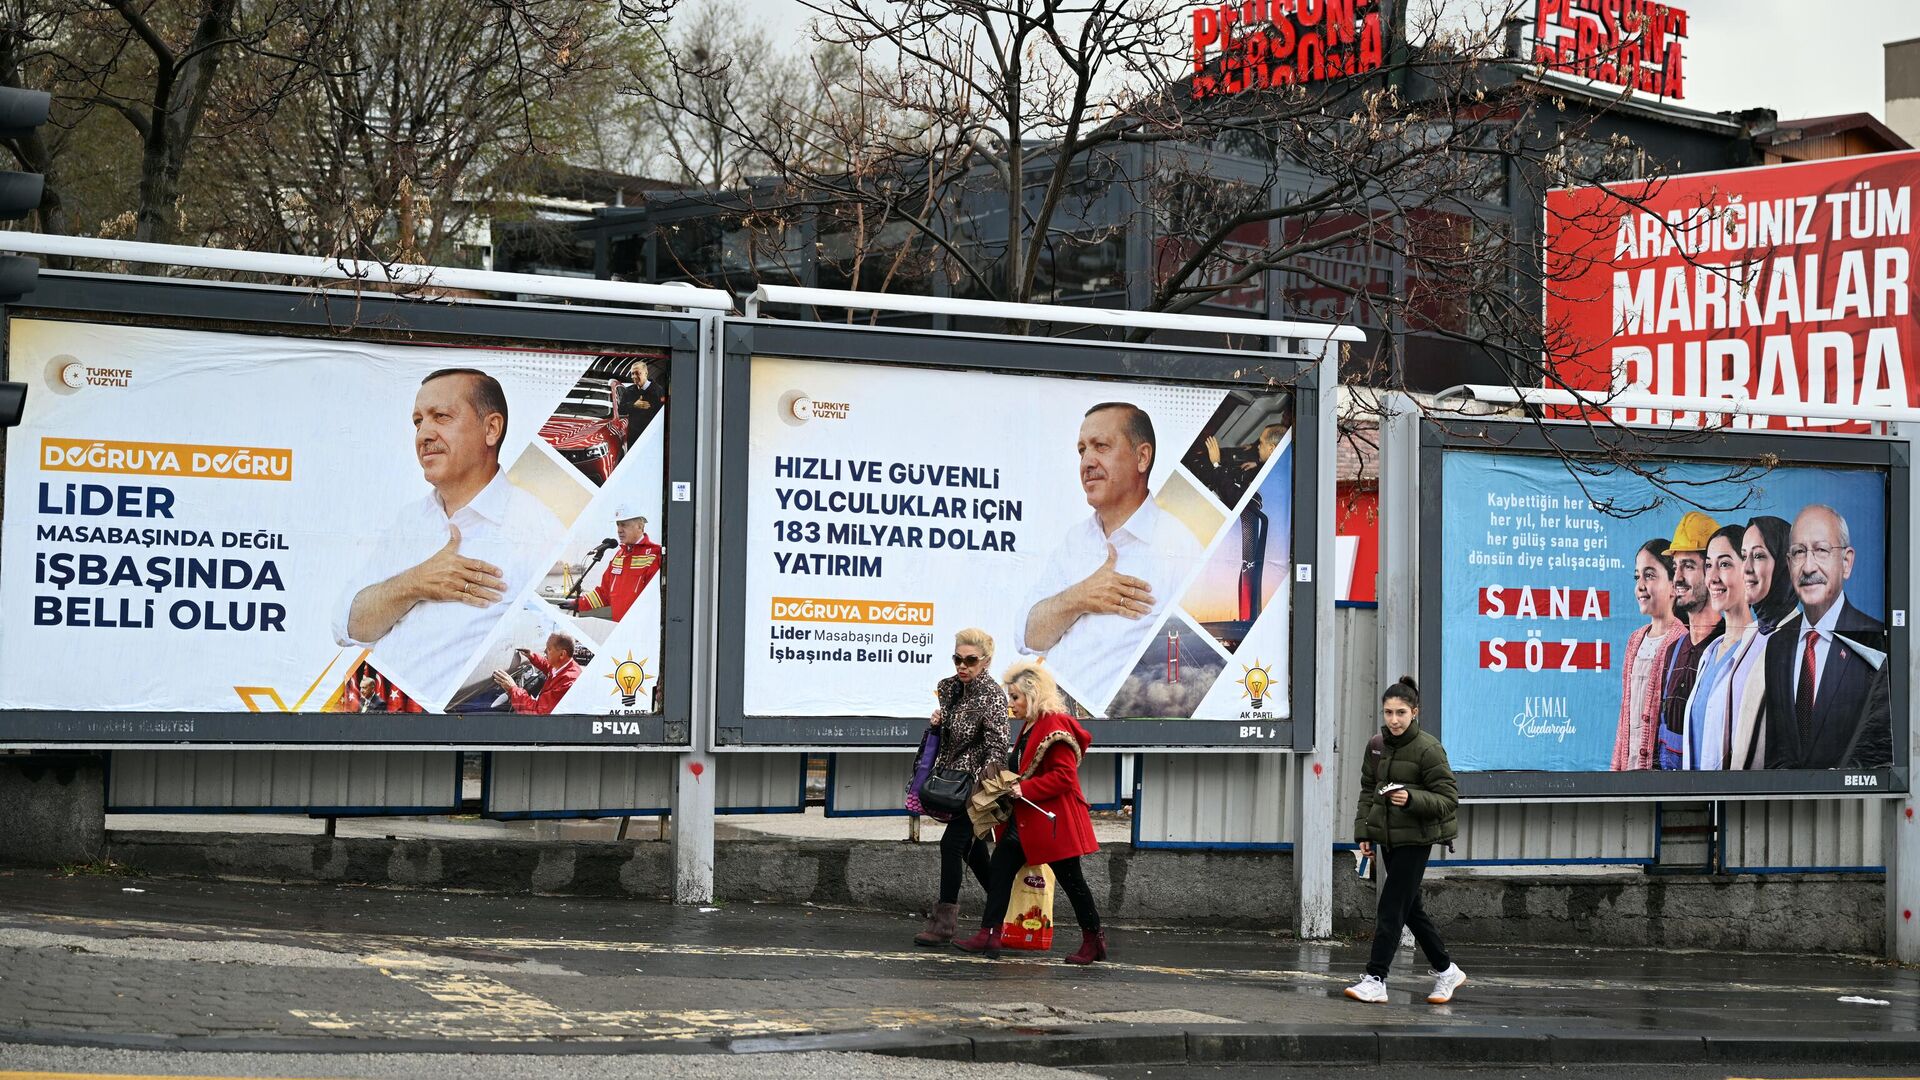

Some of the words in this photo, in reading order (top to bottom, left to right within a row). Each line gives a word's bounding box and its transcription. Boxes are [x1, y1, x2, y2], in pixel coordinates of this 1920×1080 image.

[1614, 195, 1817, 260] ARADIĞINIZ
[1826, 182, 1911, 241] TÜM
[1612, 247, 1910, 337] MARKALAR
[1611, 327, 1910, 429] BURADA
[45, 443, 181, 472] DOĞRUYA
[192, 451, 288, 476] DOĞRU
[775, 456, 842, 481] HIZLI
[848, 460, 882, 483] VE
[888, 463, 999, 489] GÜVENLİ
[38, 482, 175, 519] LİDER
[775, 488, 967, 519] YOLCULUKLAR
[973, 499, 1022, 523] İÇİN
[1488, 493, 1559, 511] Kaybettiğin
[1563, 496, 1583, 509] her
[36, 524, 215, 548] MASABAŞINDA
[221, 529, 290, 550] DEĞİL
[774, 520, 821, 543] 183
[827, 523, 923, 548] MİLYAR
[929, 528, 1016, 552] DOLAR
[1490, 512, 1511, 526] her
[1516, 513, 1536, 530] yıl,
[1540, 514, 1560, 528] her
[1565, 515, 1604, 533] kuruş,
[1487, 531, 1507, 545] her
[1512, 532, 1546, 550] gülüş
[1551, 538, 1579, 548] sana
[1583, 536, 1607, 551] geri
[35, 552, 286, 594] İŞBAŞINDA
[774, 552, 882, 578] YATIRIM
[1469, 550, 1513, 566] dönsün
[1518, 552, 1543, 570] diye
[1548, 553, 1625, 571] çalışacağım.
[33, 595, 155, 629] BELLİ
[169, 599, 287, 632] OLUR
[774, 600, 862, 620] DOĞRUYA
[869, 604, 931, 622] DOĞRU
[1486, 583, 1603, 621] SANA
[771, 625, 812, 640] Lider
[814, 629, 898, 644] Masabaşında
[902, 632, 934, 647] Değil
[770, 642, 852, 664] İşbaşında
[857, 649, 893, 663] Belli
[897, 650, 933, 664] Olur
[1488, 630, 1602, 673] SÖZ!
[1525, 696, 1569, 718] KEMAL
[1240, 726, 1277, 738] BEL
[1844, 775, 1878, 786] BELYA
